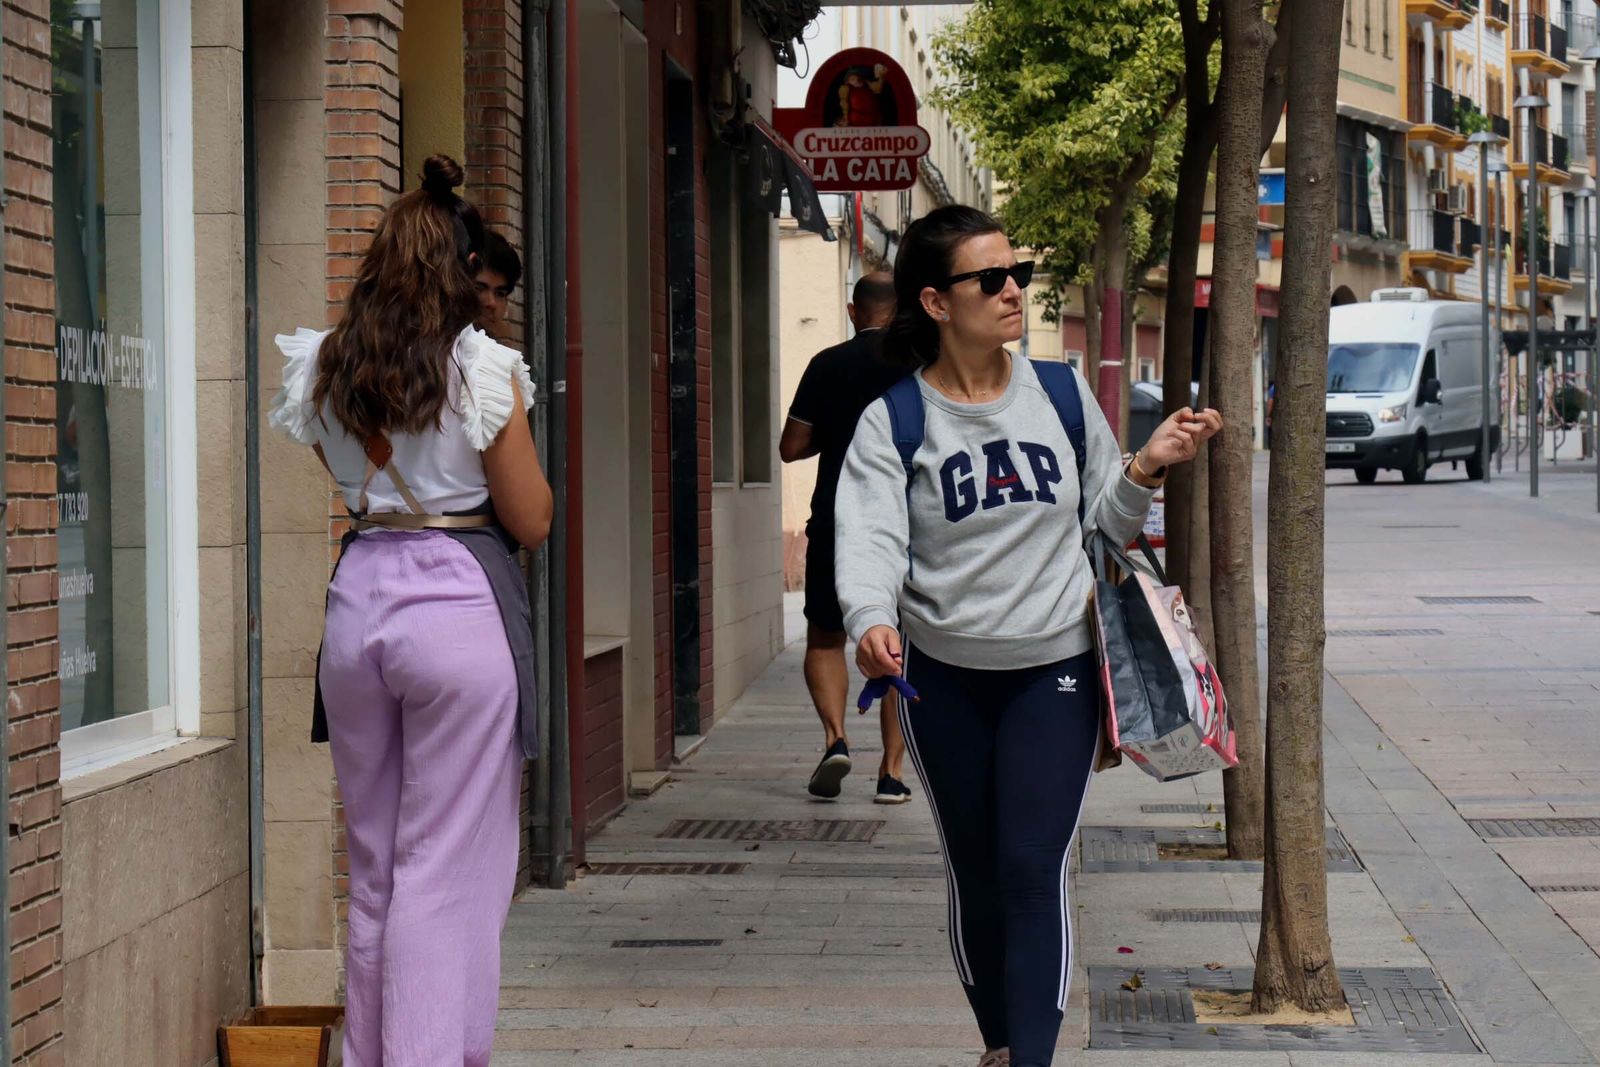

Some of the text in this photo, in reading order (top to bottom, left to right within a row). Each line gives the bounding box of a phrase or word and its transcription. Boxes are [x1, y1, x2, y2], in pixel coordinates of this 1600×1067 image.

[803, 133, 918, 154] Cruzcampo
[808, 158, 912, 182] LA CATA
[60, 317, 113, 386] DEPILACIÓN
[121, 323, 158, 391] ESTÉTICA
[939, 438, 1062, 523] GAP
[64, 492, 76, 523] 783
[77, 491, 88, 521] 920
